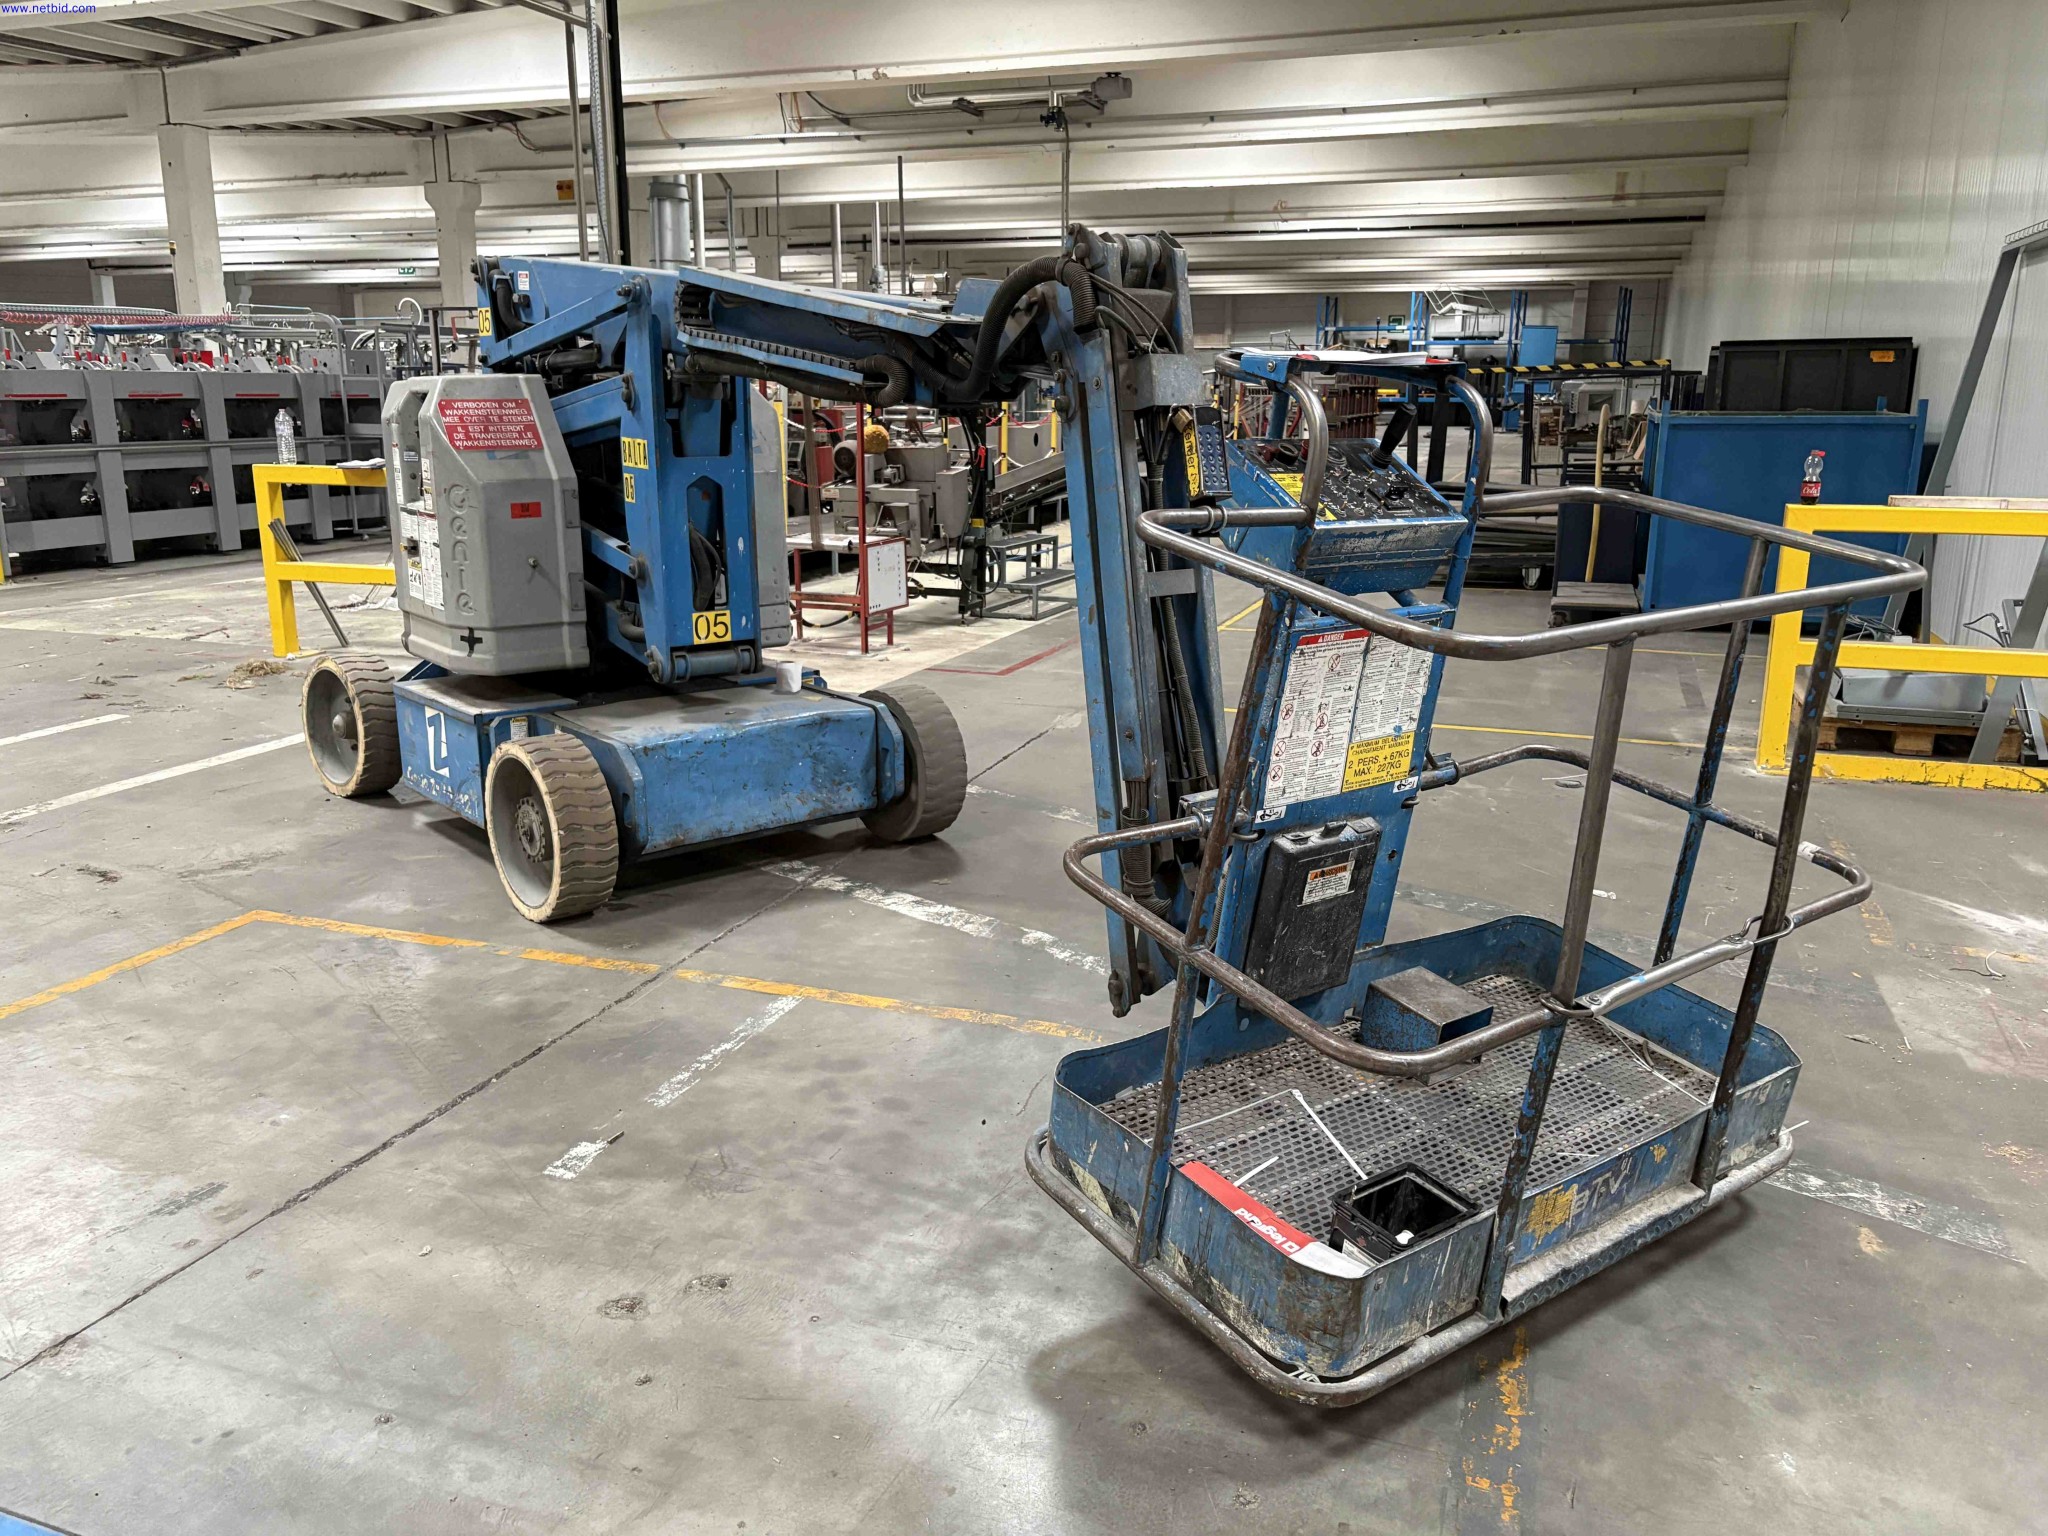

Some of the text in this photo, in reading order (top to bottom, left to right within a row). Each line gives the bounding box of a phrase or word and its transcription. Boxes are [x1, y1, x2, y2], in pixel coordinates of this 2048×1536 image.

[478, 309, 491, 333] 05
[444, 408, 528, 416] WAKKENSTEENWEG
[451, 401, 499, 409] VERBODEN
[453, 431, 533, 440] DE TRAVERSER LE
[454, 439, 538, 447] WAKKENSTEENWEG
[622, 440, 648, 467] BALTA
[624, 476, 635, 501] 05
[694, 612, 729, 641] 05
[1323, 632, 1345, 642] DANGER
[1348, 760, 1354, 770] 2
[1357, 755, 1380, 768] PERS.
[1390, 748, 1410, 761] 67KG
[1377, 760, 1402, 773] 227KG
[1233, 1207, 1288, 1245] legrand
